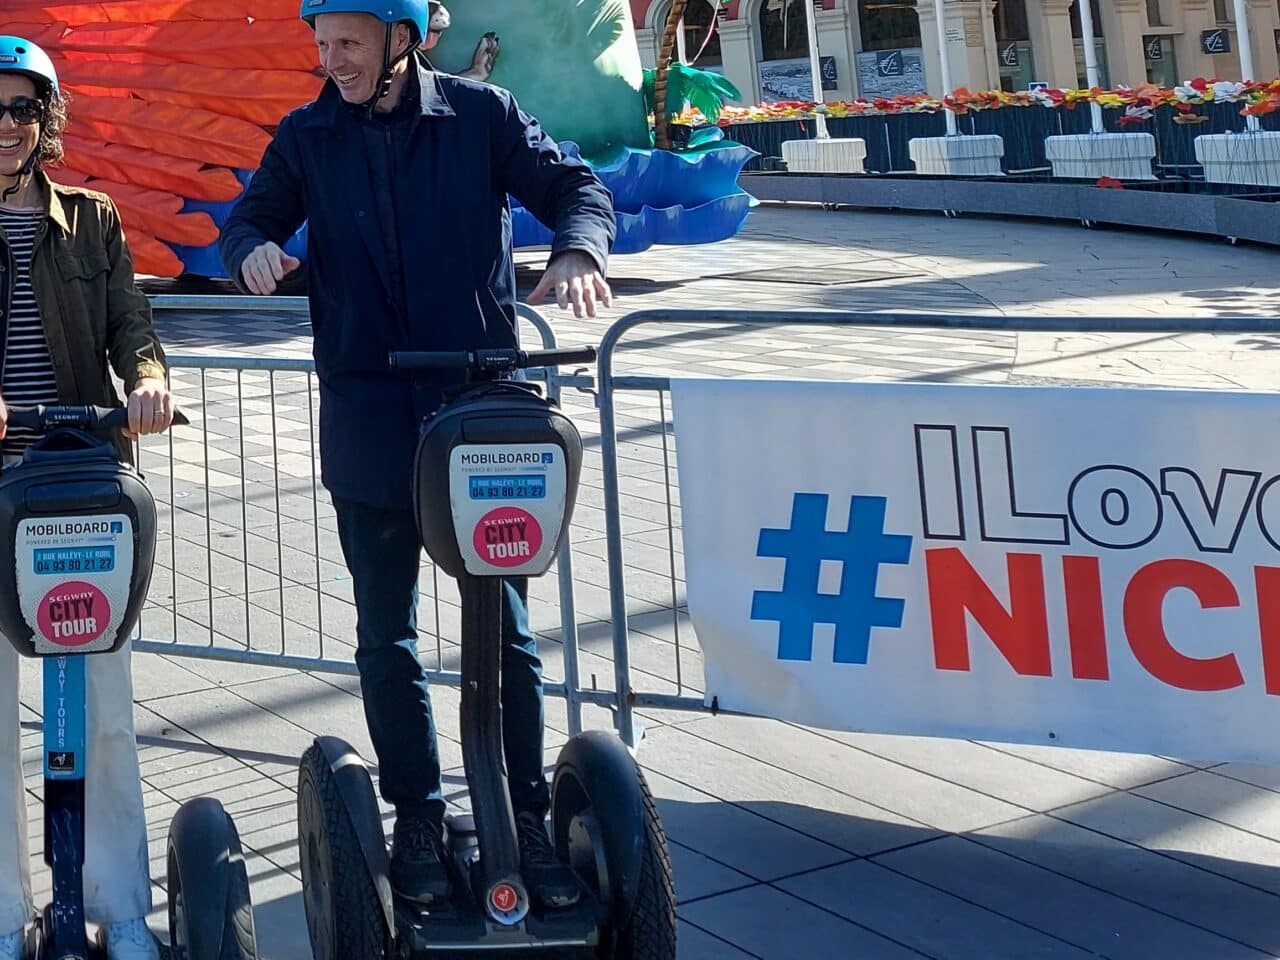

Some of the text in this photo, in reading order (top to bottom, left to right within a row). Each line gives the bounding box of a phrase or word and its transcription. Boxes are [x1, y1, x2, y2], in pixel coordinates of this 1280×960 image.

[461, 453, 540, 465] MOBILBOARD
[473, 486, 543, 497] 04 93 80 21 27
[26, 522, 109, 536] MOBILBOARD
[485, 522, 527, 544] CITY
[487, 541, 530, 559] TOUR
[37, 559, 111, 572] 04 93 80 21 27
[49, 591, 94, 602] SEGWAY
[49, 597, 94, 623] CITY
[51, 617, 97, 638] TOUR
[57, 656, 67, 747] WAY TOURS
